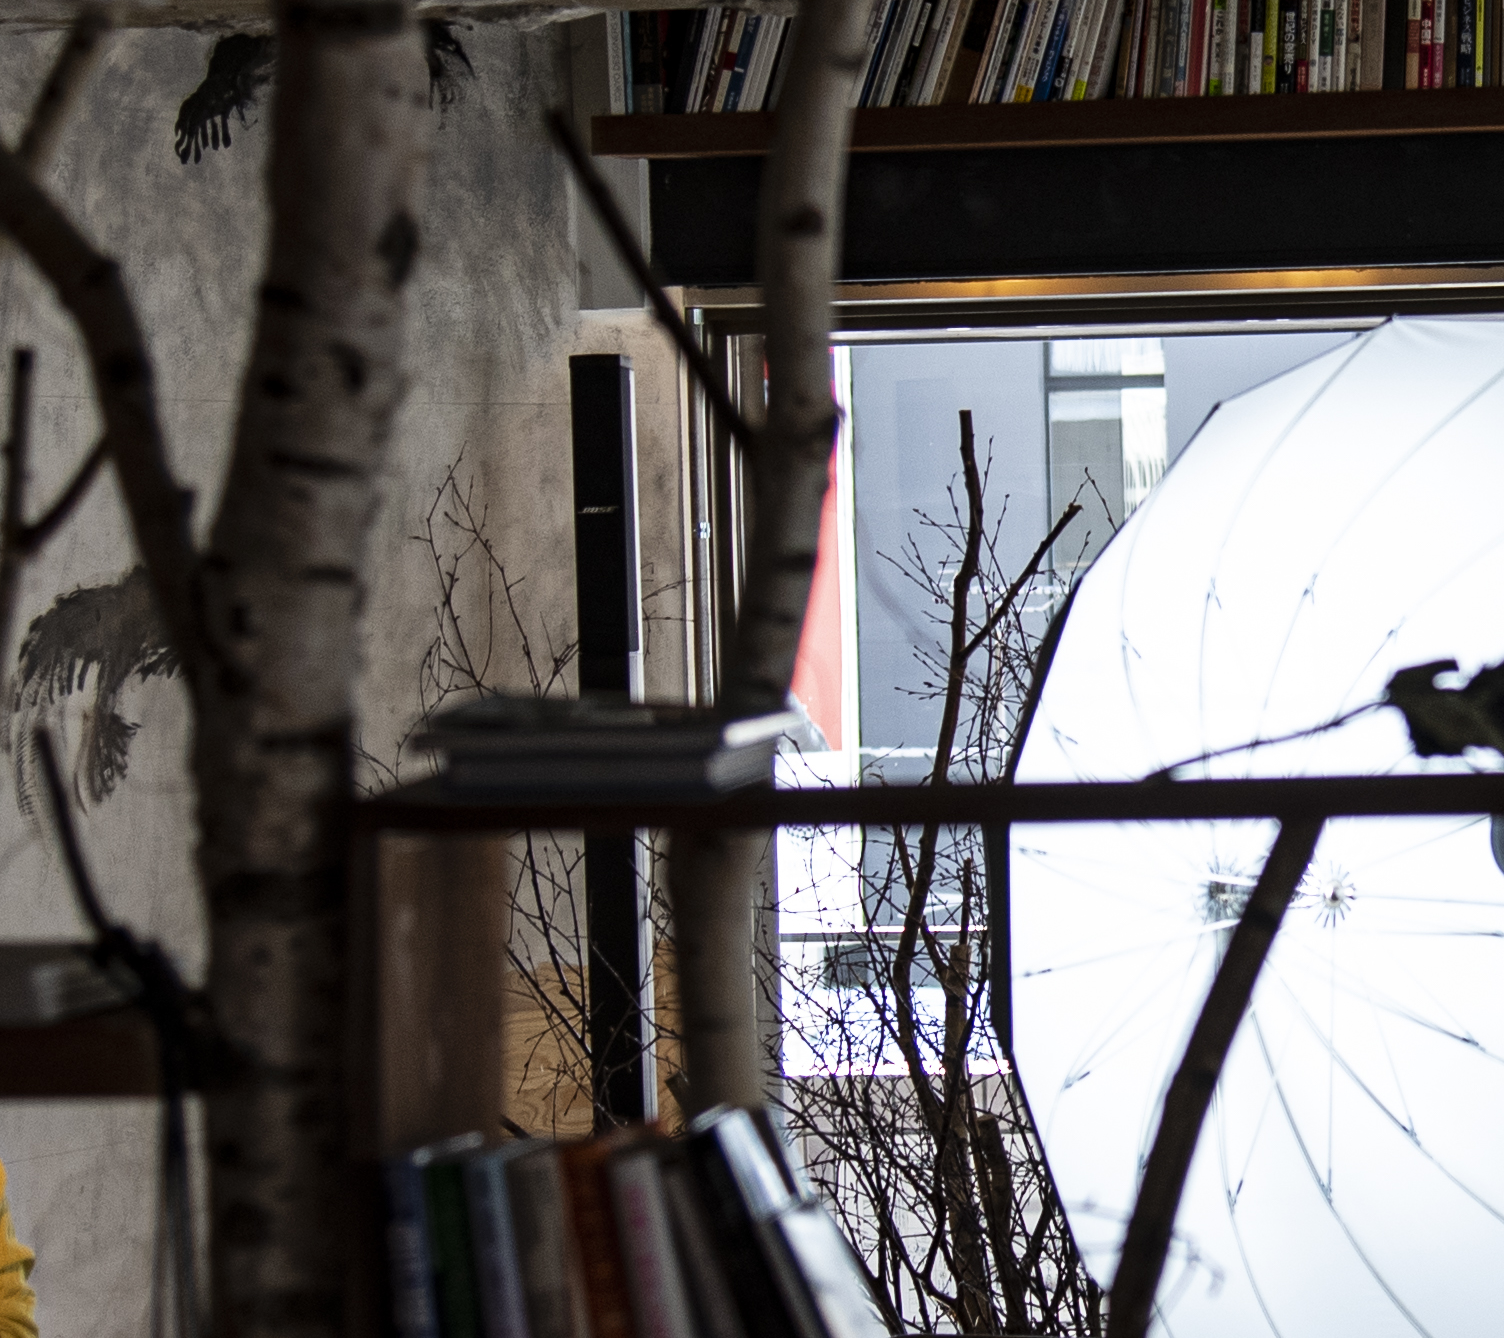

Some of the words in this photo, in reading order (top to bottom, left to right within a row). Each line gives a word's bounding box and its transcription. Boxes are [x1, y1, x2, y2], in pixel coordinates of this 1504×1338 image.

[1283, 11, 1296, 75] 世紀の空売り
